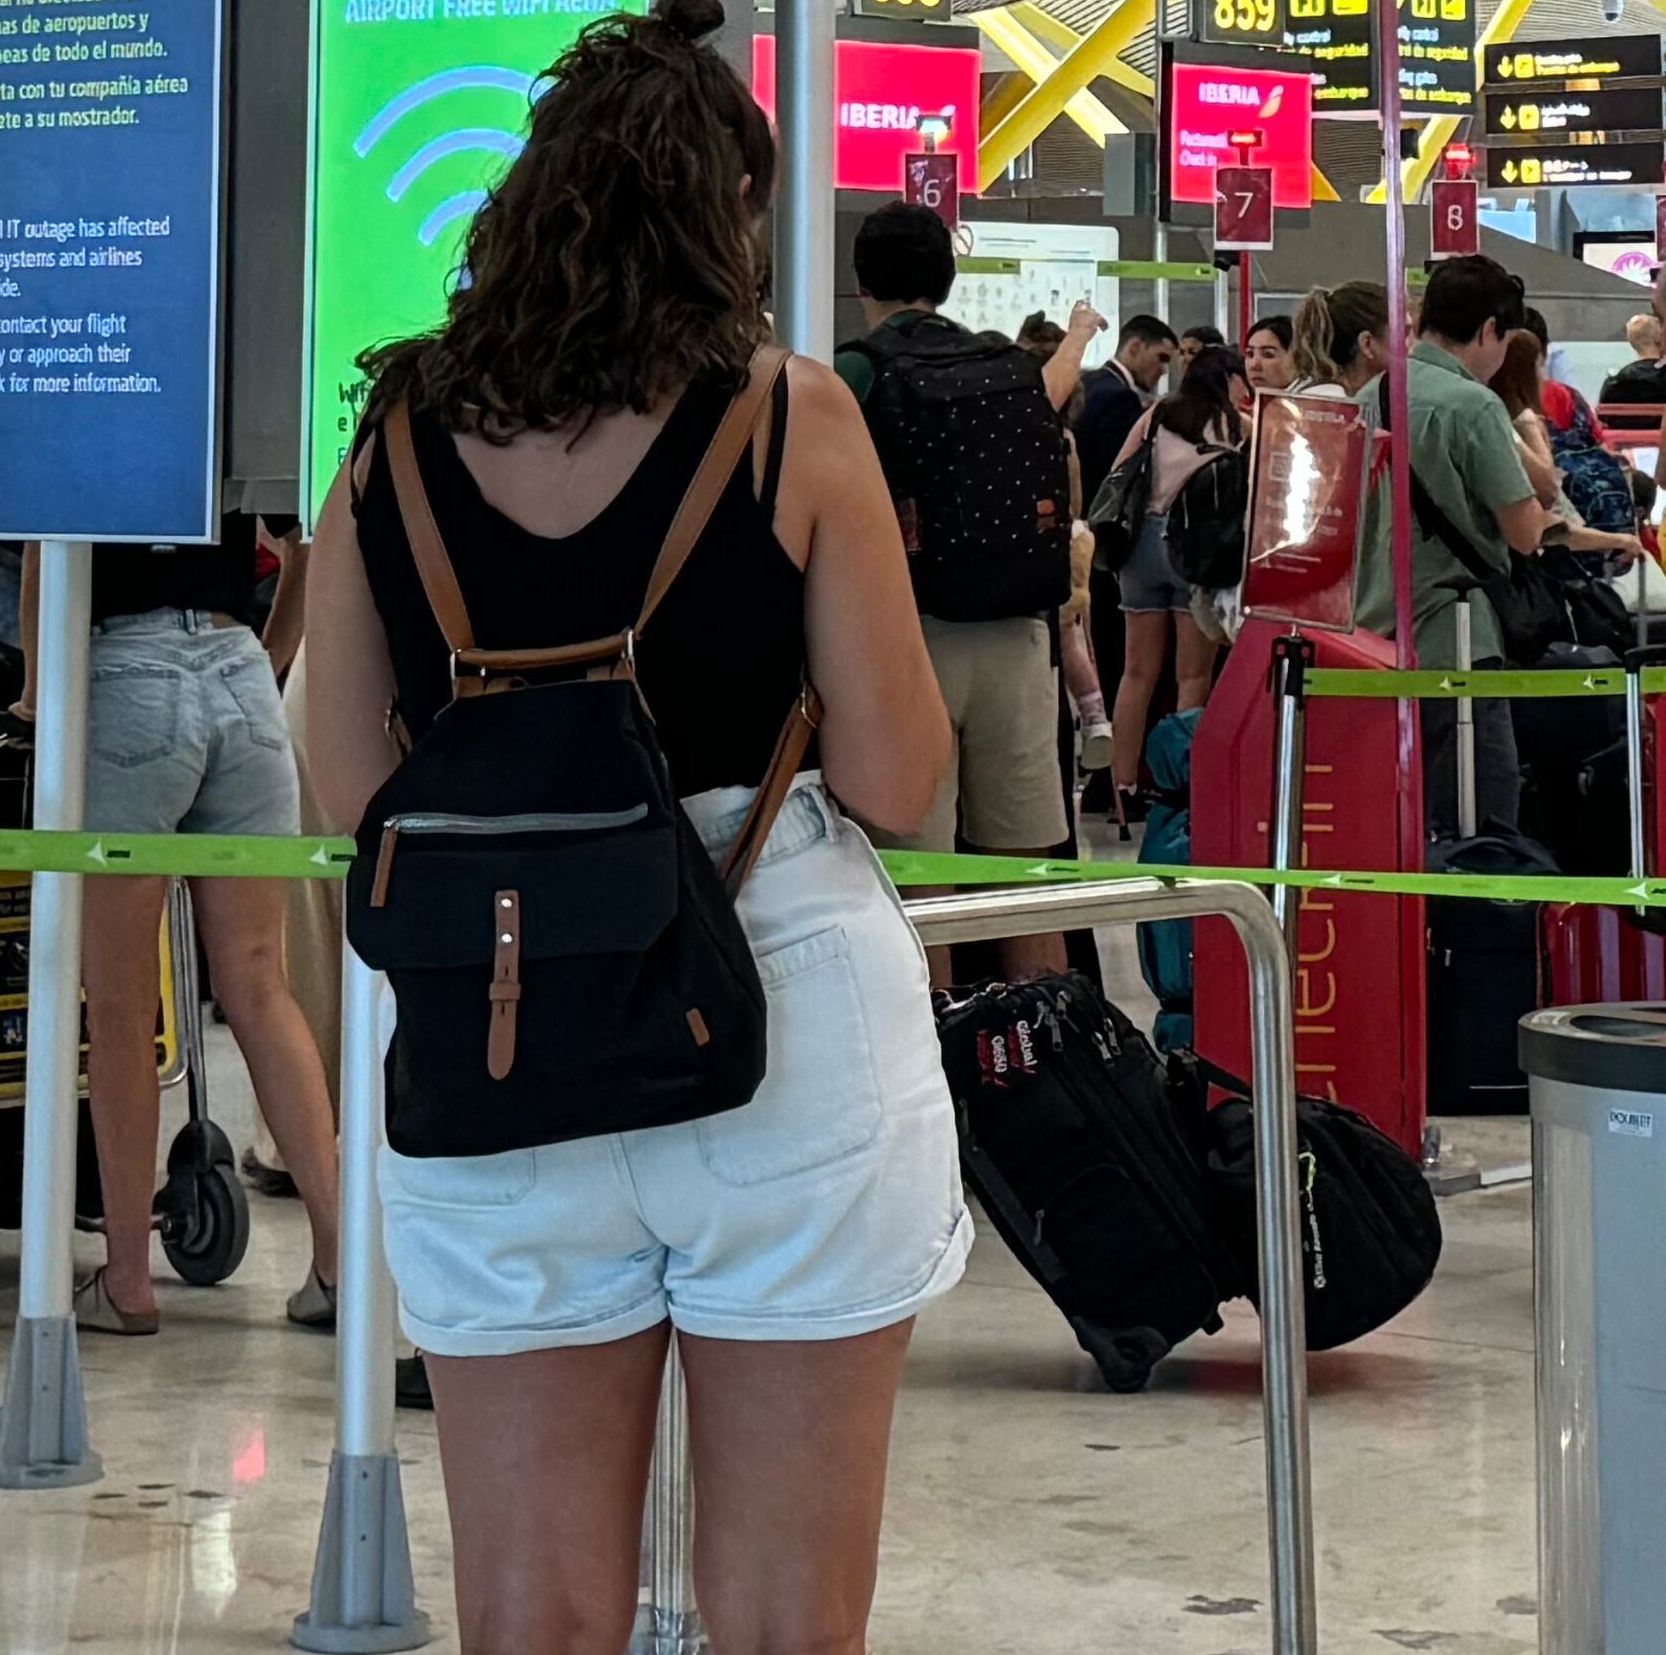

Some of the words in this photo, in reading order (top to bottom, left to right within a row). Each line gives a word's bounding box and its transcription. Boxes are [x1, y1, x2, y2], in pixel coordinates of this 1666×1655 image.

[22, 14, 41, 34] de
[44, 11, 136, 36] aeropuertos
[138, 13, 149, 34] y
[32, 43, 51, 62] de
[55, 43, 89, 61] todo
[93, 40, 107, 59] el
[111, 37, 168, 59] mundo.
[19, 84, 45, 99] con
[49, 80, 65, 98] tu
[69, 74, 141, 101] compañía
[145, 74, 189, 94] aérea
[1198, 83, 1261, 106] IBERIA
[25, 113, 34, 128] a
[37, 112, 55, 127] su
[58, 105, 140, 126] mostrador.
[841, 103, 919, 129] IBERIA
[924, 179, 941, 207] 6
[1234, 192, 1254, 218] 7
[6, 219, 21, 239] IT
[24, 221, 76, 243] outage
[79, 218, 106, 237] has
[108, 215, 171, 236] affected
[1447, 204, 1464, 231] 8
[59, 247, 85, 267] and
[89, 246, 143, 266] airlines
[51, 318, 84, 338] your
[87, 313, 127, 337] flight
[9, 348, 24, 363] or
[27, 343, 93, 368] approach
[97, 342, 131, 363] their
[10, 372, 30, 392] for
[34, 376, 70, 392] more
[73, 372, 162, 392] information.
